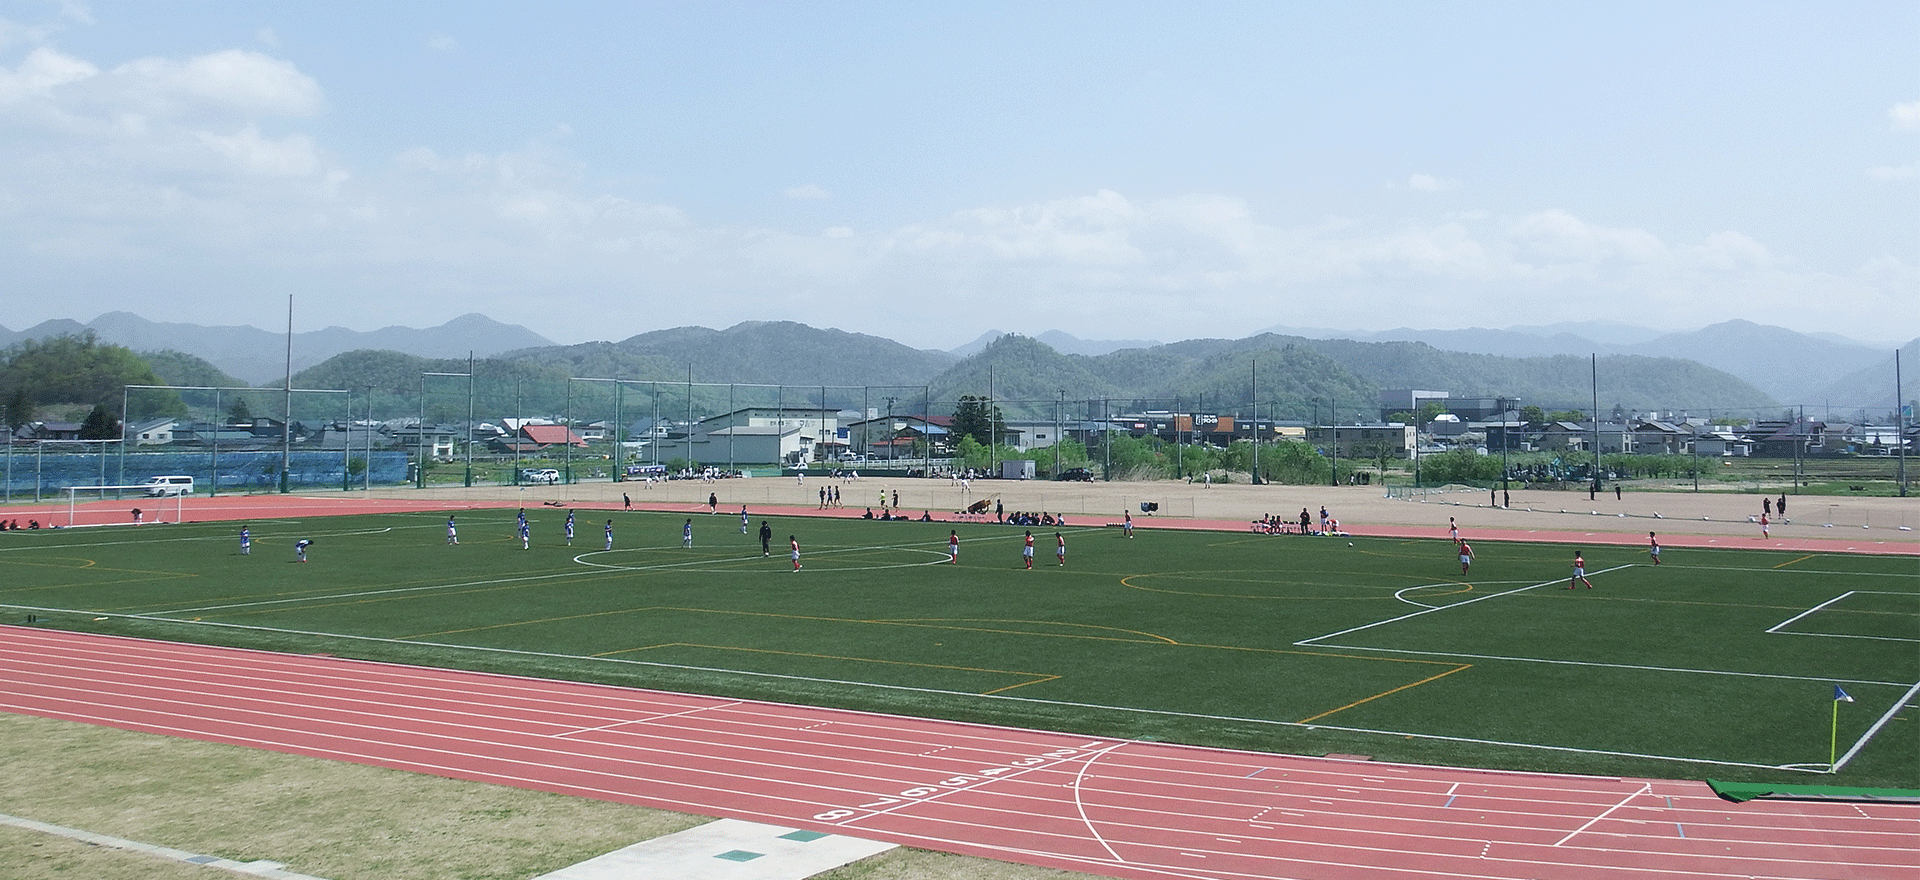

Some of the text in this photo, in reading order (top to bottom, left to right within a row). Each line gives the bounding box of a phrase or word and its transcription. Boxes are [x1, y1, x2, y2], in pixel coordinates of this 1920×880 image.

[1042, 749, 1077, 758] 2
[1012, 758, 1044, 766] 3
[979, 768, 1011, 776] 4
[940, 776, 979, 786] 5
[901, 787, 937, 796] 6
[860, 798, 901, 807] 7
[813, 810, 854, 821] 8
